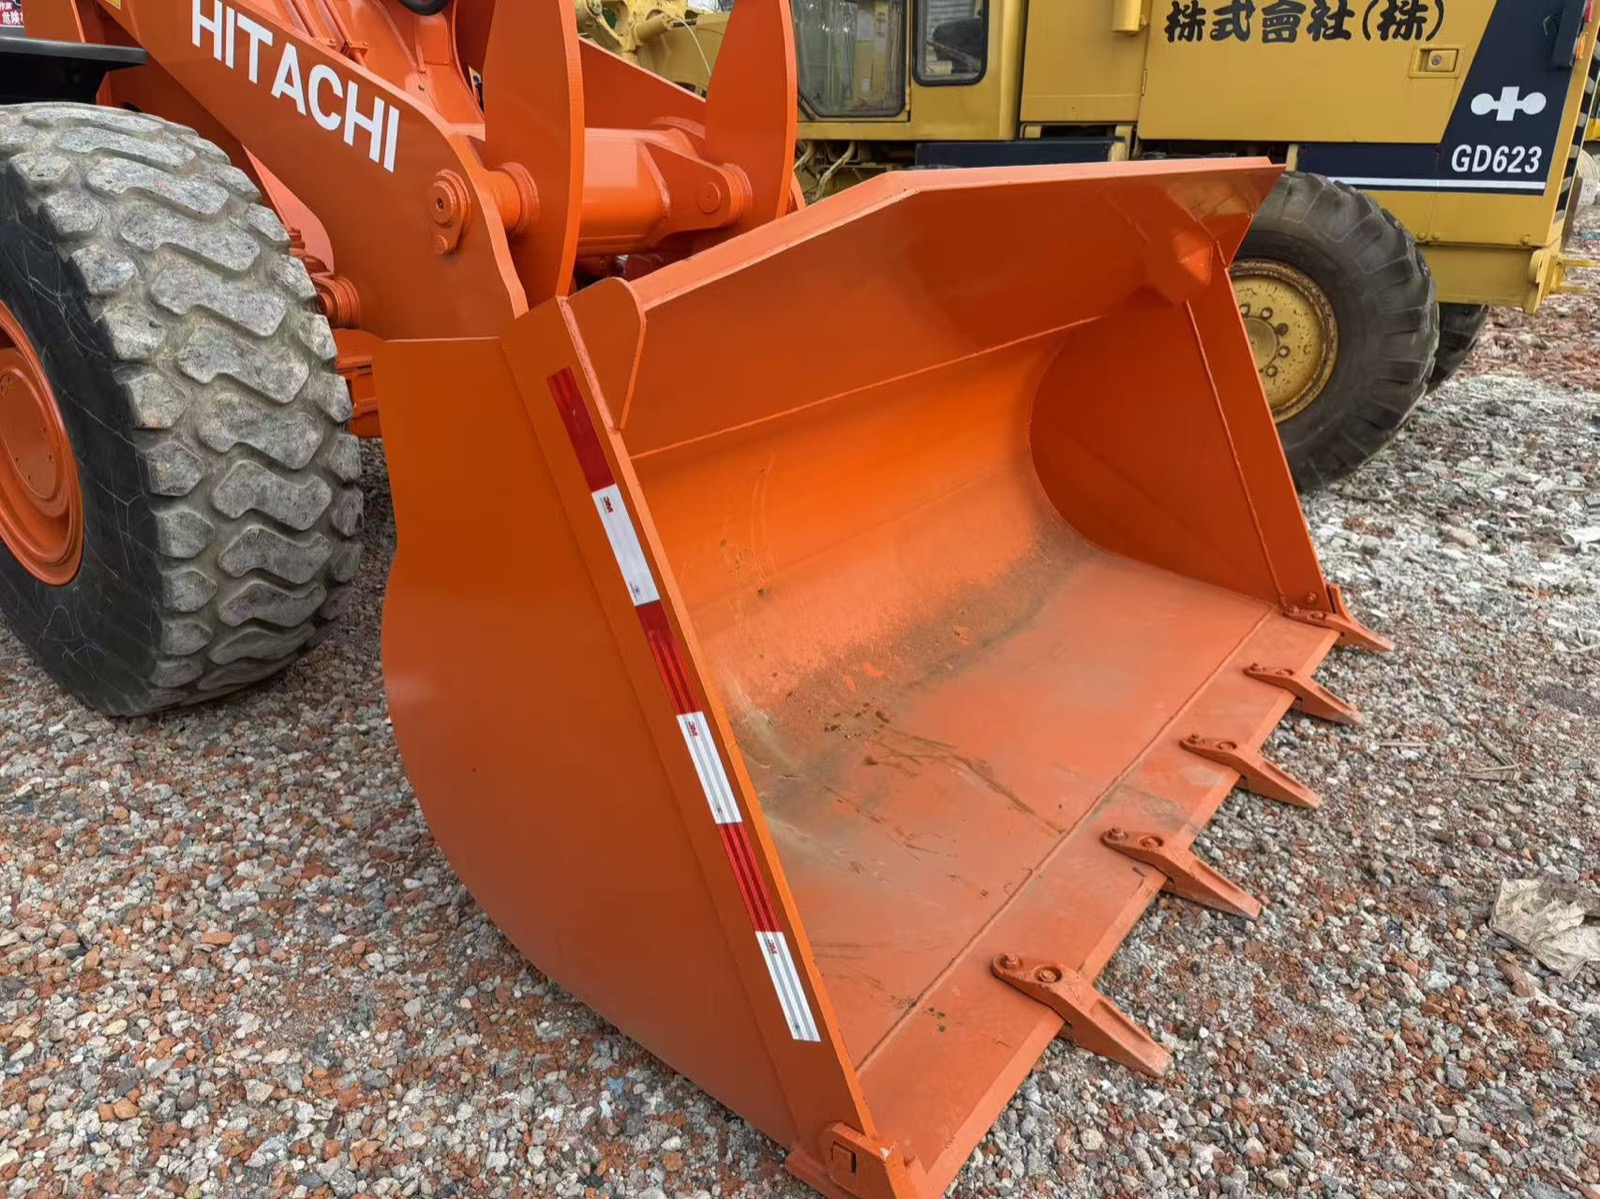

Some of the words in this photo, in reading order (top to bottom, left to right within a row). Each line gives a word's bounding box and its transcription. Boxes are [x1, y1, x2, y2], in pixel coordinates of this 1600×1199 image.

[192, 0, 400, 173] HITACHI
[1451, 144, 1542, 174] GD623
[603, 495, 614, 513] 3M
[688, 720, 699, 737] 3M
[767, 938, 778, 955] 3M
